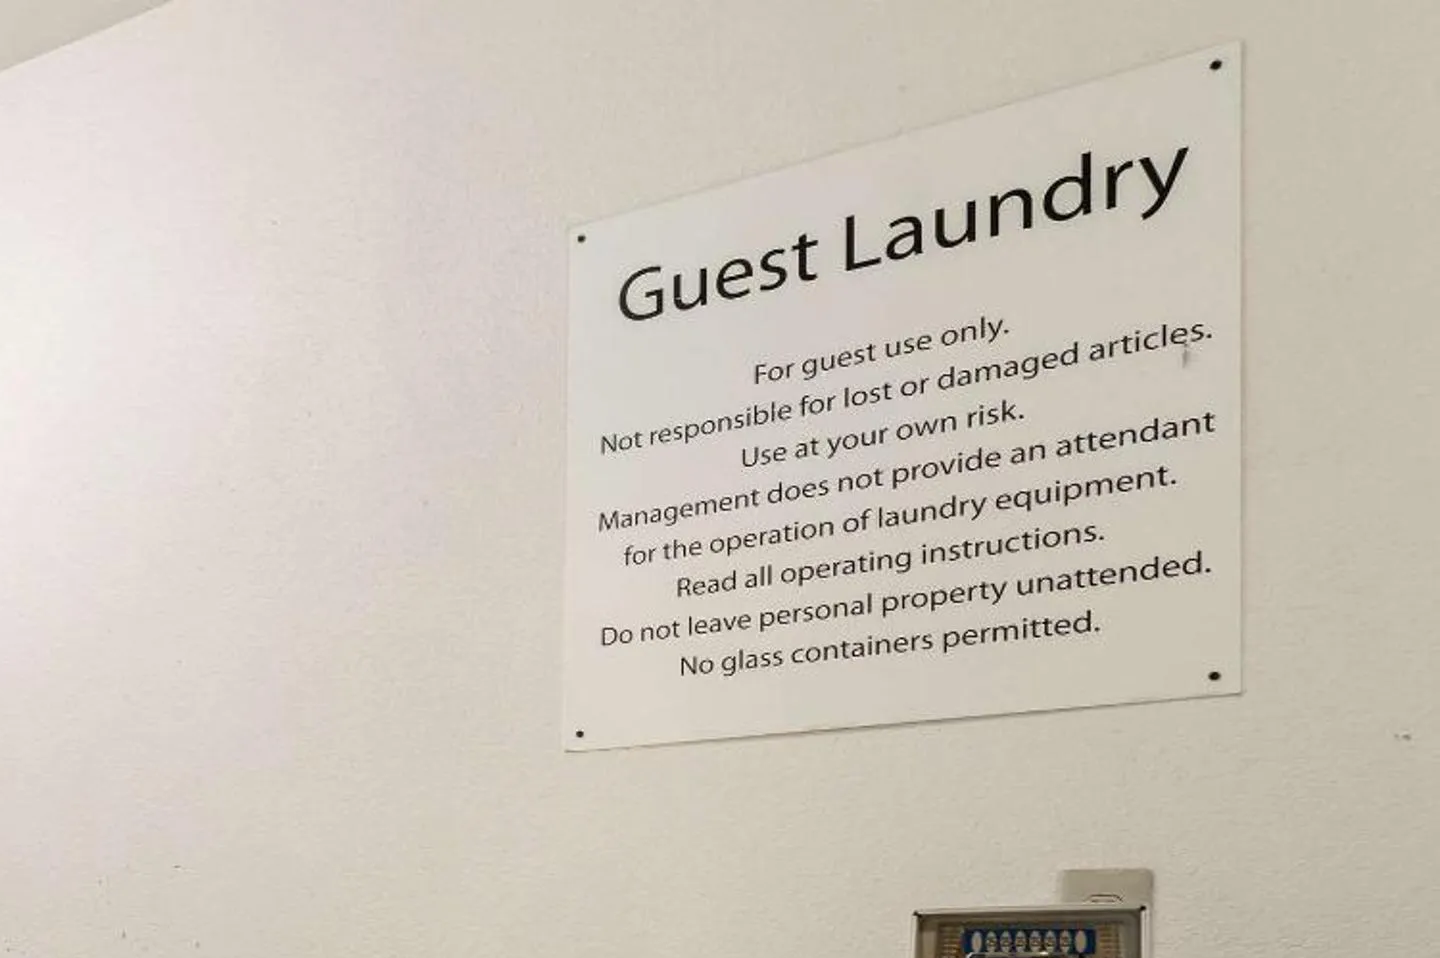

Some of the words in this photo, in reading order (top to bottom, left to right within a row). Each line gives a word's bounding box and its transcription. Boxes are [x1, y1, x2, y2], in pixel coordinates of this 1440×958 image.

[618, 232, 819, 322] Guest
[844, 145, 1190, 272] Laundry
[600, 431, 643, 455] Not
[649, 400, 793, 446] responsible
[798, 394, 837, 418] for
[843, 381, 893, 409] lost
[899, 376, 931, 397] or
[936, 340, 1079, 391] damaged
[1088, 323, 1213, 362] articles.
[754, 362, 796, 385] For
[801, 343, 877, 381] guest
[884, 334, 933, 359] use
[939, 315, 1010, 347] only.
[598, 488, 761, 533] Management
[766, 479, 831, 505] does
[837, 467, 885, 493] not
[891, 446, 1002, 491] provide
[1009, 444, 1046, 466] an
[1055, 411, 1216, 458] attendant
[741, 446, 789, 468] Use
[794, 437, 821, 460] at
[826, 426, 890, 460] your
[895, 415, 958, 441] own
[966, 399, 1025, 429] risk.
[623, 544, 658, 567] for
[662, 538, 703, 561] the
[709, 521, 835, 557] operation
[842, 507, 874, 534] of
[878, 494, 988, 529] laundry
[994, 465, 1177, 513] equipment.
[676, 569, 737, 598] Read
[744, 563, 773, 589] all
[780, 550, 913, 588] operating
[921, 525, 1105, 566] instructions.
[600, 626, 634, 647] Do
[640, 620, 681, 642] not
[688, 613, 752, 637] leave
[759, 592, 873, 633] personal
[881, 580, 1009, 619] property
[1016, 549, 1212, 597] unattended.
[680, 655, 715, 677] No
[720, 648, 785, 677] glass
[790, 633, 934, 664] containers
[942, 609, 1101, 655] permitted.
